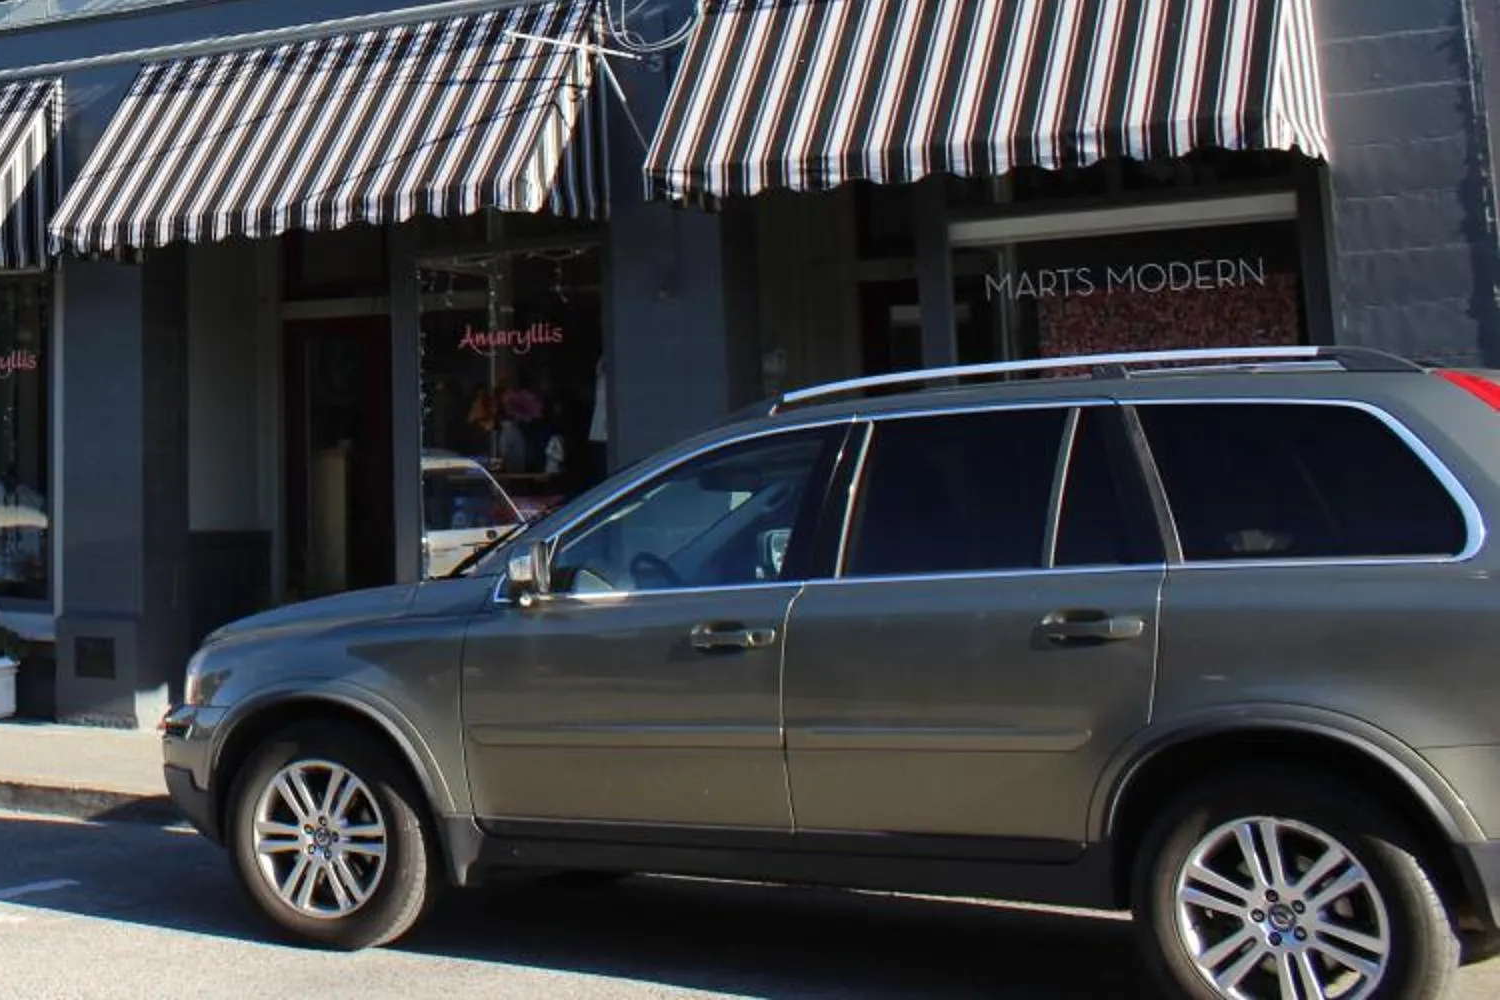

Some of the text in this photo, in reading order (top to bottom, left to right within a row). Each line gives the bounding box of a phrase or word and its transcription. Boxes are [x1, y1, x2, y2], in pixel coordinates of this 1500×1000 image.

[985, 257, 1266, 301] MARTS MODERN
[457, 322, 564, 358] Amaryllis
